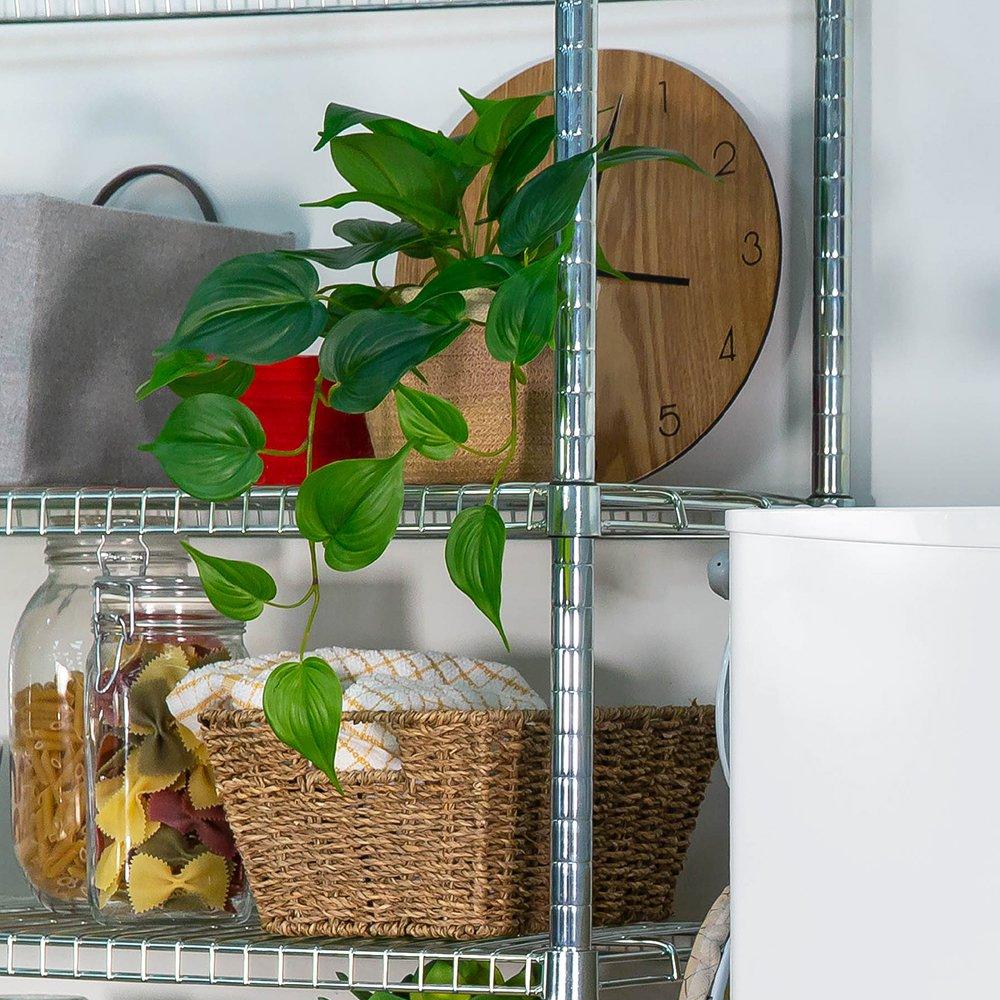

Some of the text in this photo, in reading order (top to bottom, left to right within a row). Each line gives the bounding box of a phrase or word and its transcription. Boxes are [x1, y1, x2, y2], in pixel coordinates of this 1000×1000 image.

[658, 80, 668, 113] 1
[713, 140, 736, 178] 2
[741, 230, 763, 266] 3
[719, 325, 737, 362] 4
[658, 403, 681, 437] 5
